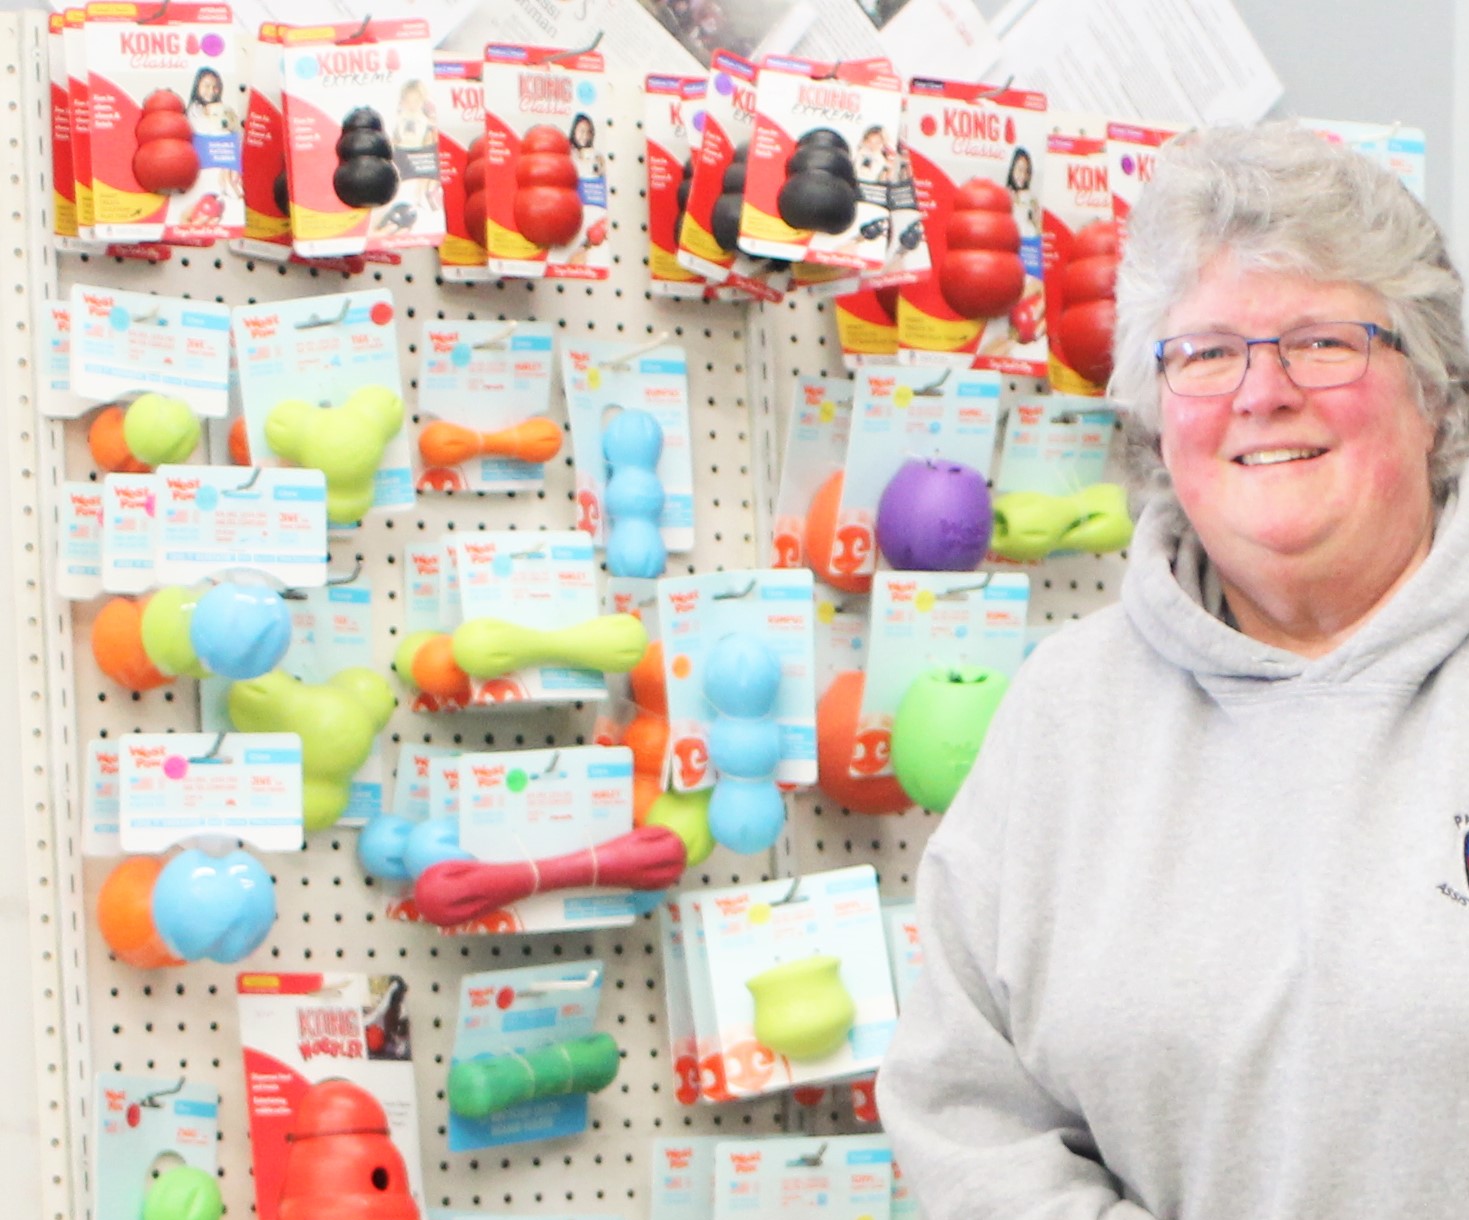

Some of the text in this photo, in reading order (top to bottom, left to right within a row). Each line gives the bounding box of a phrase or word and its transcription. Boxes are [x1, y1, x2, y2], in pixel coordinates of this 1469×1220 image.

[120, 31, 180, 55] KONG
[129, 52, 188, 70] Classic
[316, 50, 381, 76] KONG
[323, 71, 393, 89] EXTREME
[519, 72, 573, 101] KONG
[451, 87, 485, 109] KO
[733, 86, 757, 113] KO
[798, 83, 862, 113] KONG
[943, 109, 1000, 143] KONG
[1067, 164, 1109, 192] KON
[297, 1005, 361, 1038] KONG
